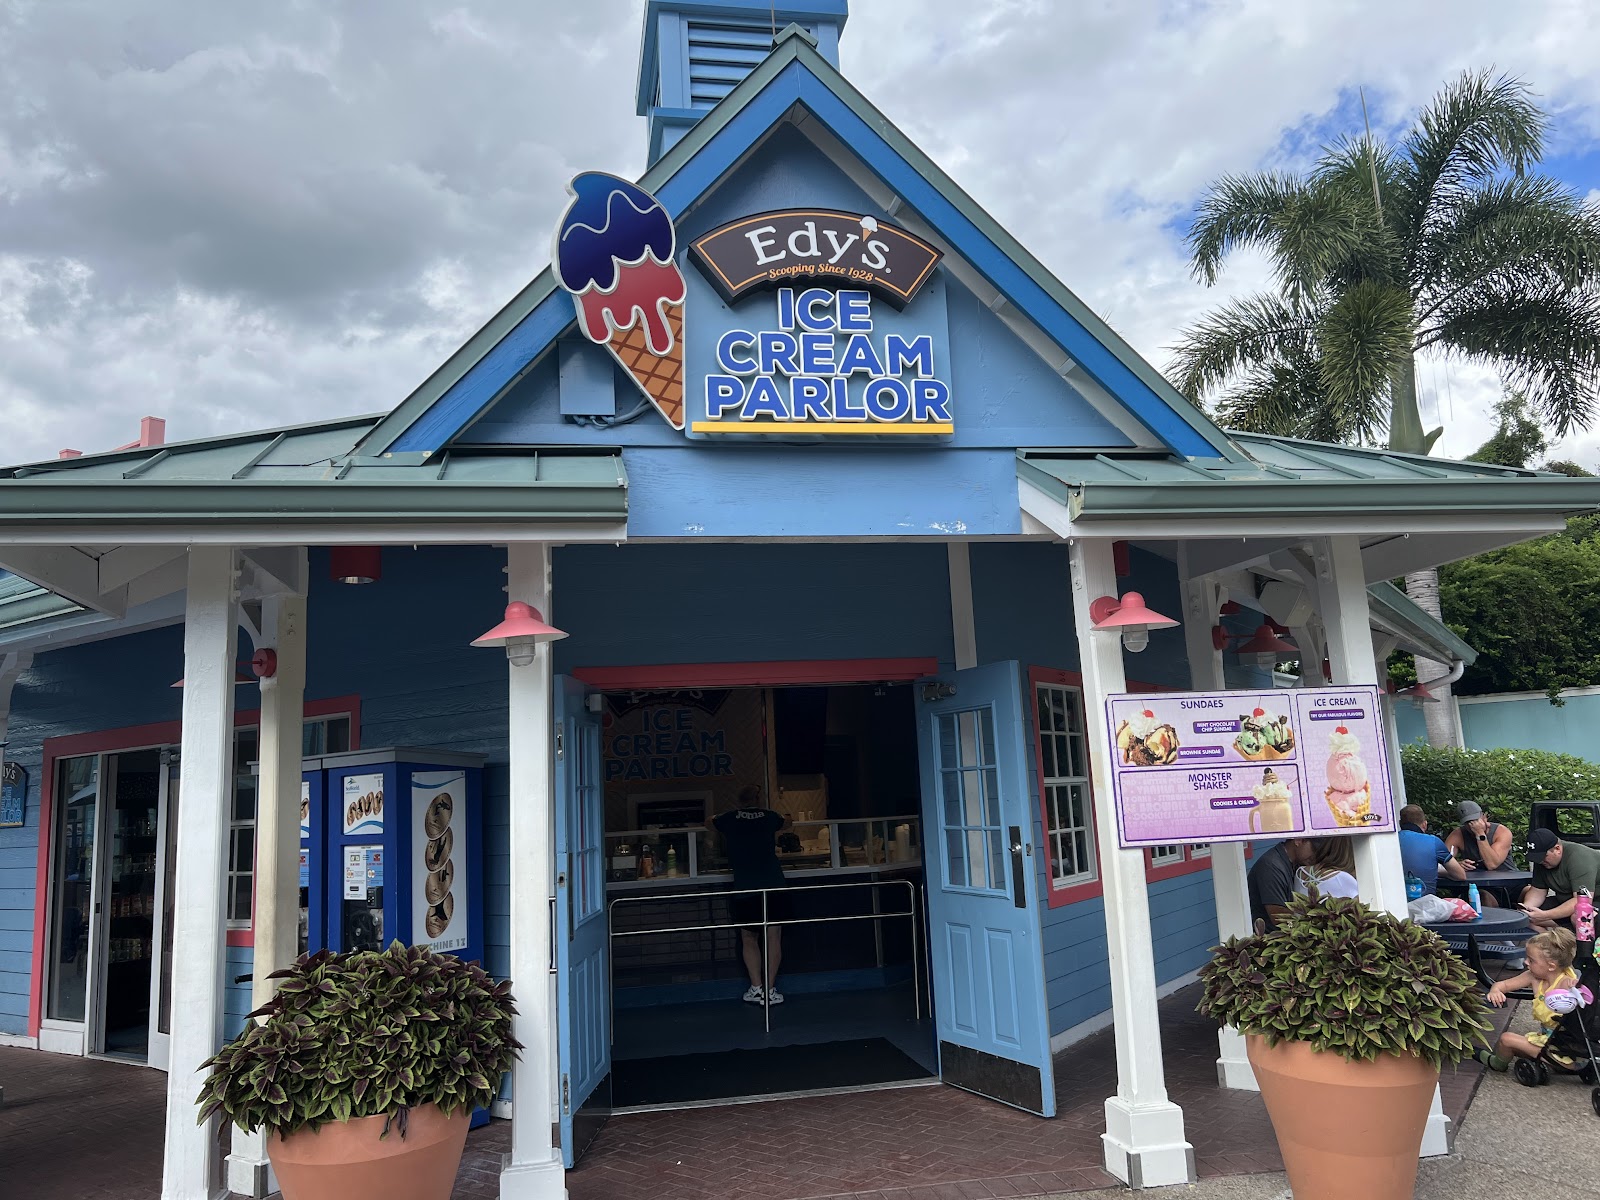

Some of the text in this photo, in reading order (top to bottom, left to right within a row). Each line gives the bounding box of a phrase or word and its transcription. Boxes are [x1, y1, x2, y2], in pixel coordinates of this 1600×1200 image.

[769, 263, 875, 282] Scooping Since 1928
[777, 287, 874, 334] ICE
[716, 329, 934, 378] CREAM
[704, 374, 953, 422] PARLOR
[1180, 700, 1224, 709] SUNDAES
[1329, 698, 1357, 706] CREAM
[642, 708, 694, 733] ICE
[611, 730, 726, 759] CREAM
[604, 752, 736, 782] PARLOR
[1188, 772, 1232, 782] MONSTER
[1193, 781, 1229, 791] SHAKES
[735, 810, 766, 820] Joma
[429, 939, 453, 951] CHINE
